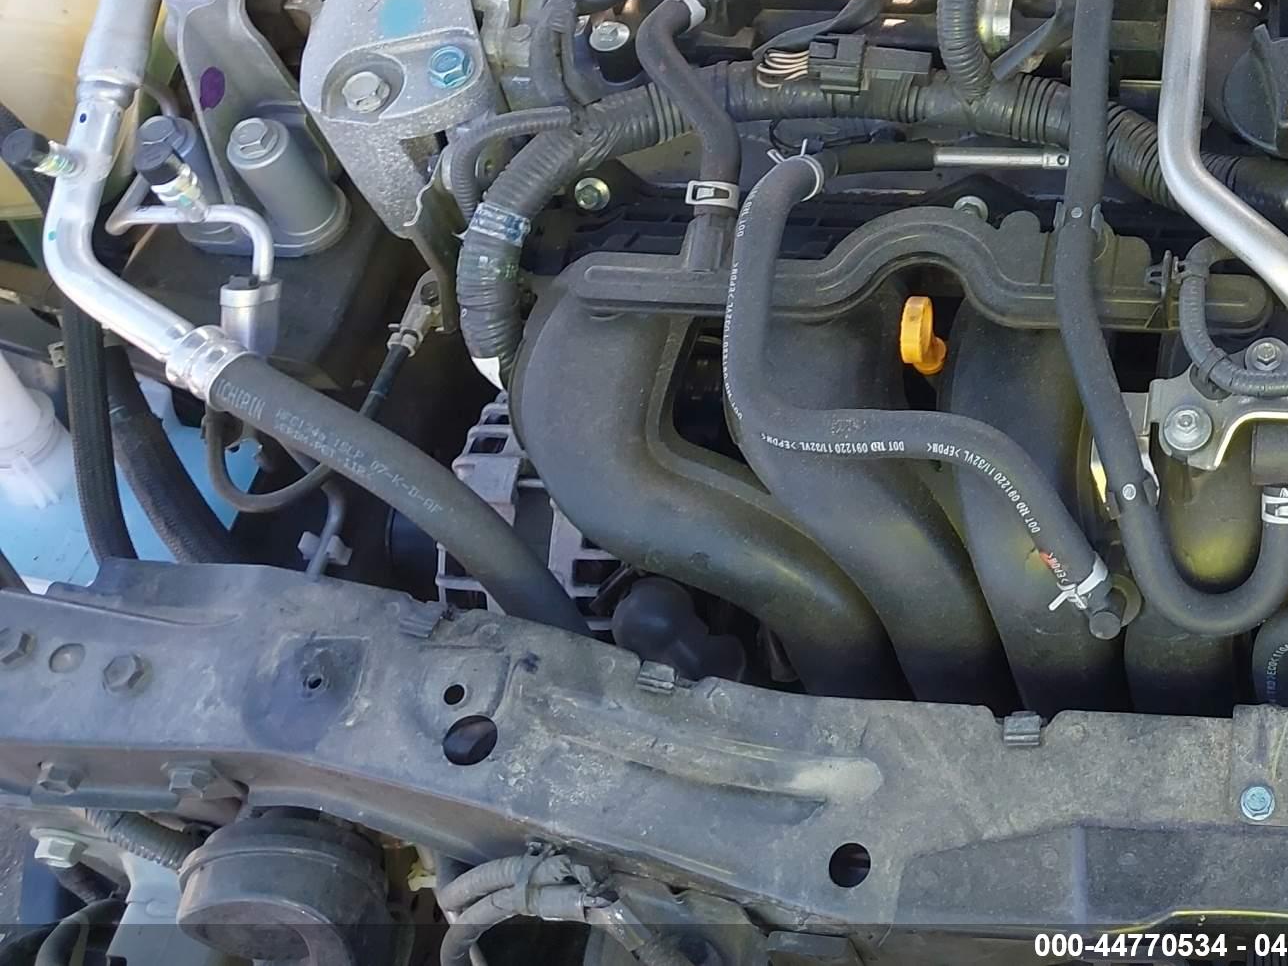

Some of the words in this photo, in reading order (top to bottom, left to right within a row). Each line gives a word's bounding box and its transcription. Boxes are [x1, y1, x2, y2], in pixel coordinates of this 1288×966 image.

[834, 442, 869, 454] 091220
[888, 440, 905, 452] DOT
[926, 442, 961, 458] >EPDM<
[993, 472, 1021, 503] 091220
[1025, 517, 1041, 535] DOT
